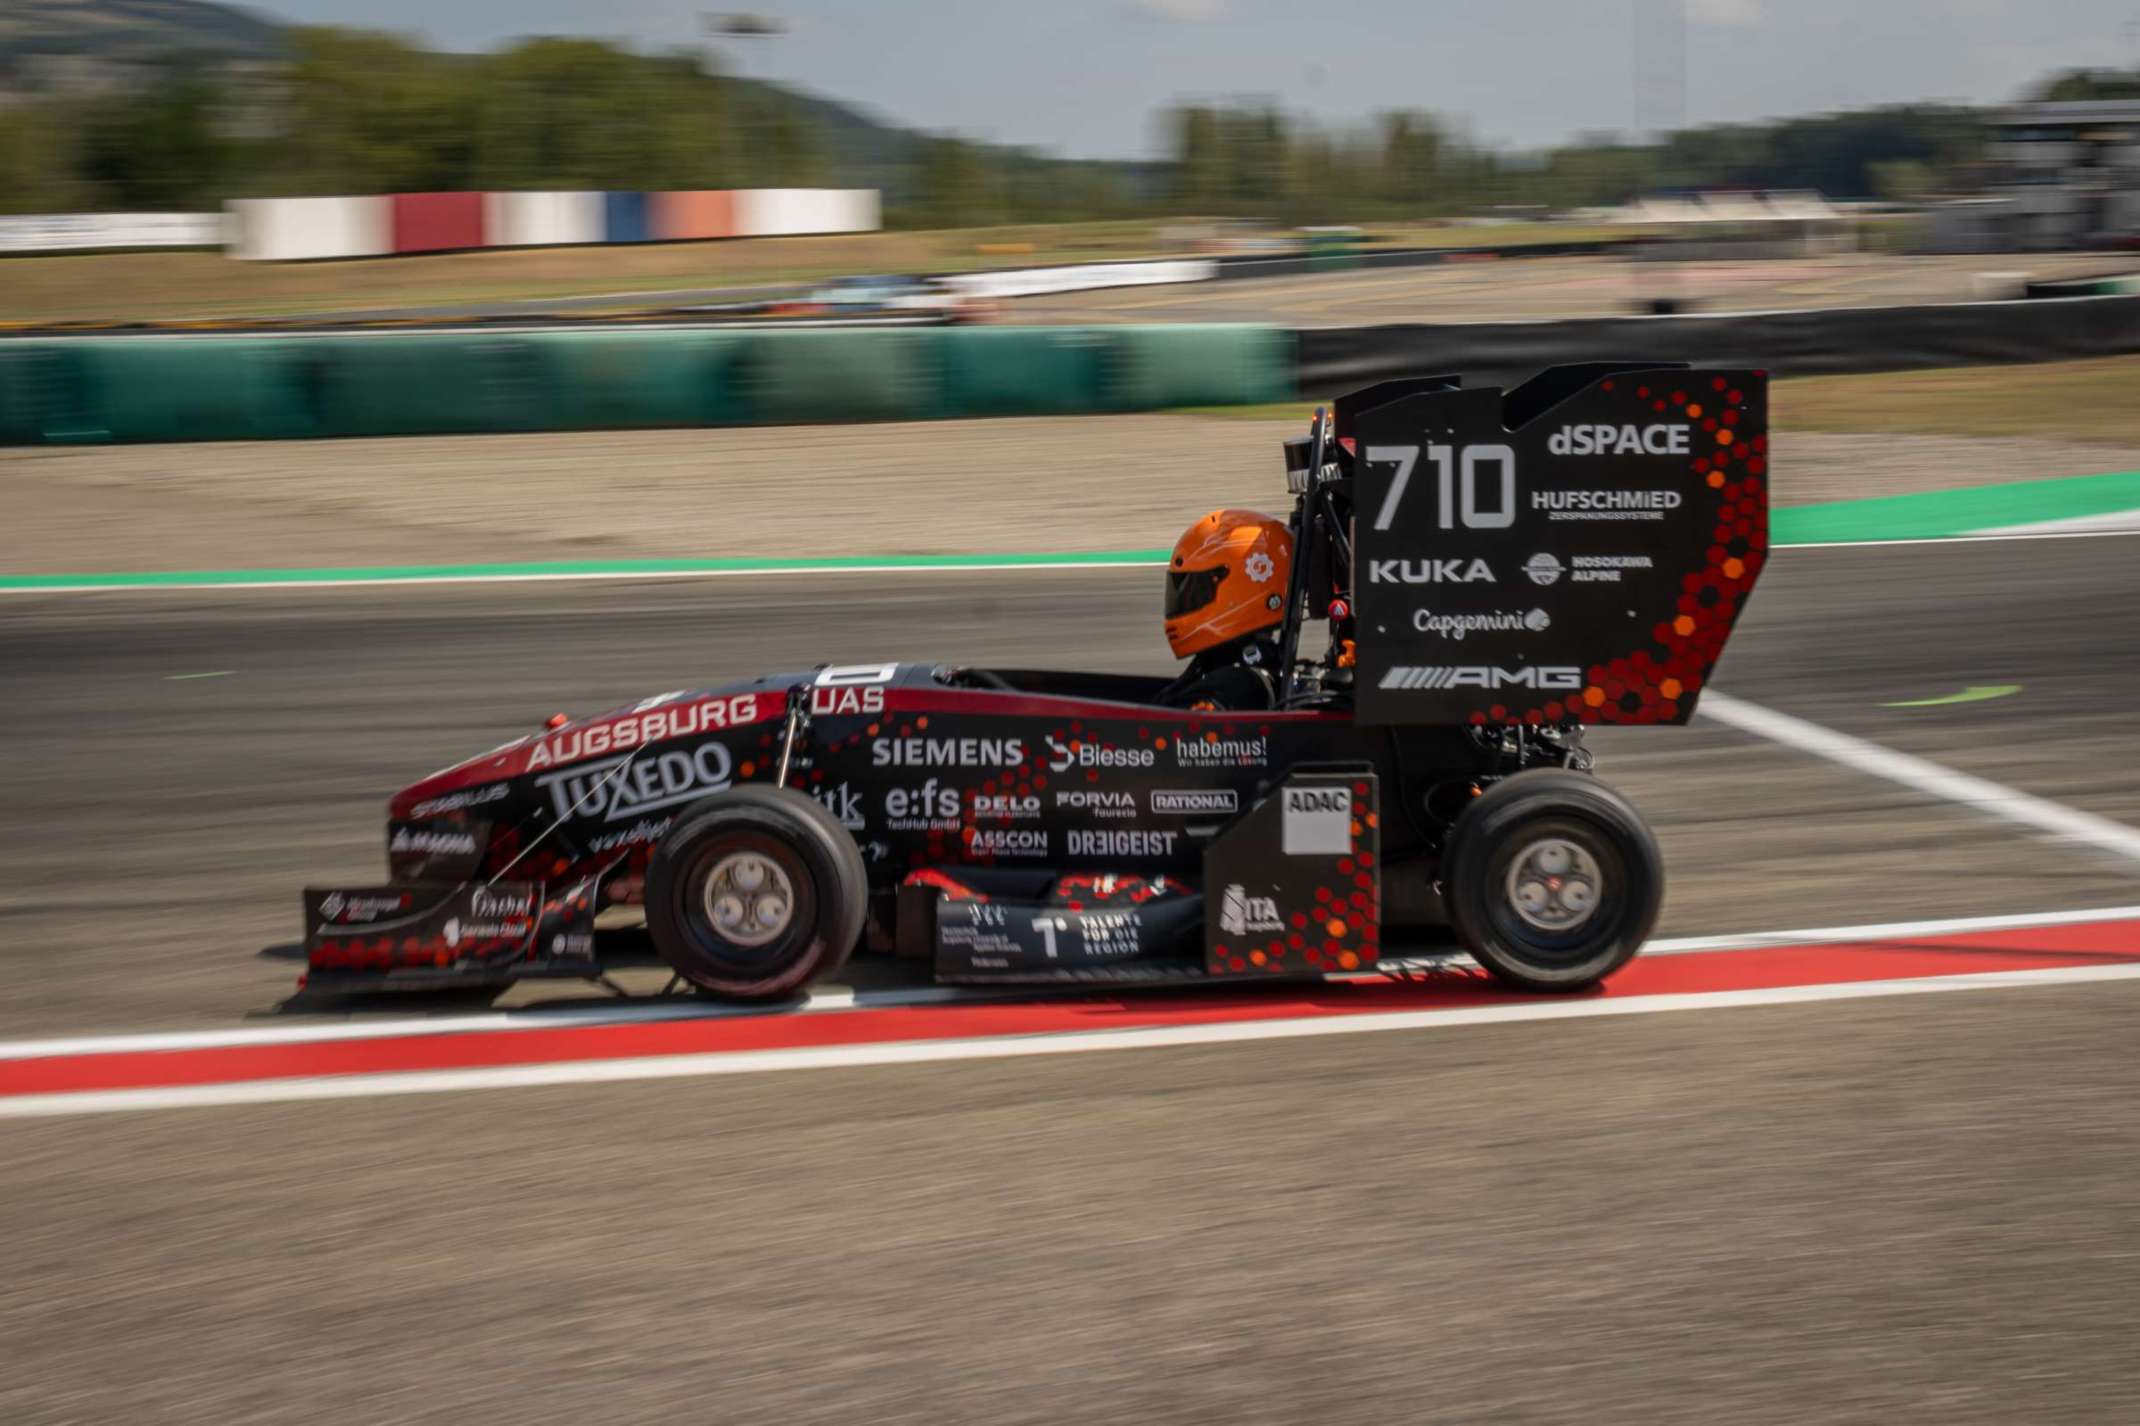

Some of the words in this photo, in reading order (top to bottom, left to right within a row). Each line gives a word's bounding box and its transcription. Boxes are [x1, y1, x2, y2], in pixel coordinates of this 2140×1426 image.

[1548, 425, 1690, 455] dSPACE
[1366, 444, 1516, 530] 710
[1369, 559, 1497, 584] KUKA
[1413, 608, 1524, 640] Capgemini
[1442, 667, 1581, 689] AMG
[811, 686, 885, 715] UAS
[525, 694, 757, 773] AUGSBURG
[872, 737, 1024, 766] SIEMENS
[1079, 744, 1155, 767] Biesse
[1177, 736, 1268, 758] habemus!
[534, 741, 732, 822] TUXEDO
[885, 777, 960, 817] e:fs
[974, 795, 1040, 811] DELO
[1056, 791, 1136, 807] FORVIA
[1156, 795, 1233, 808] RATIONAL
[1288, 792, 1348, 813] ADAC
[971, 831, 1047, 848] ASSCON
